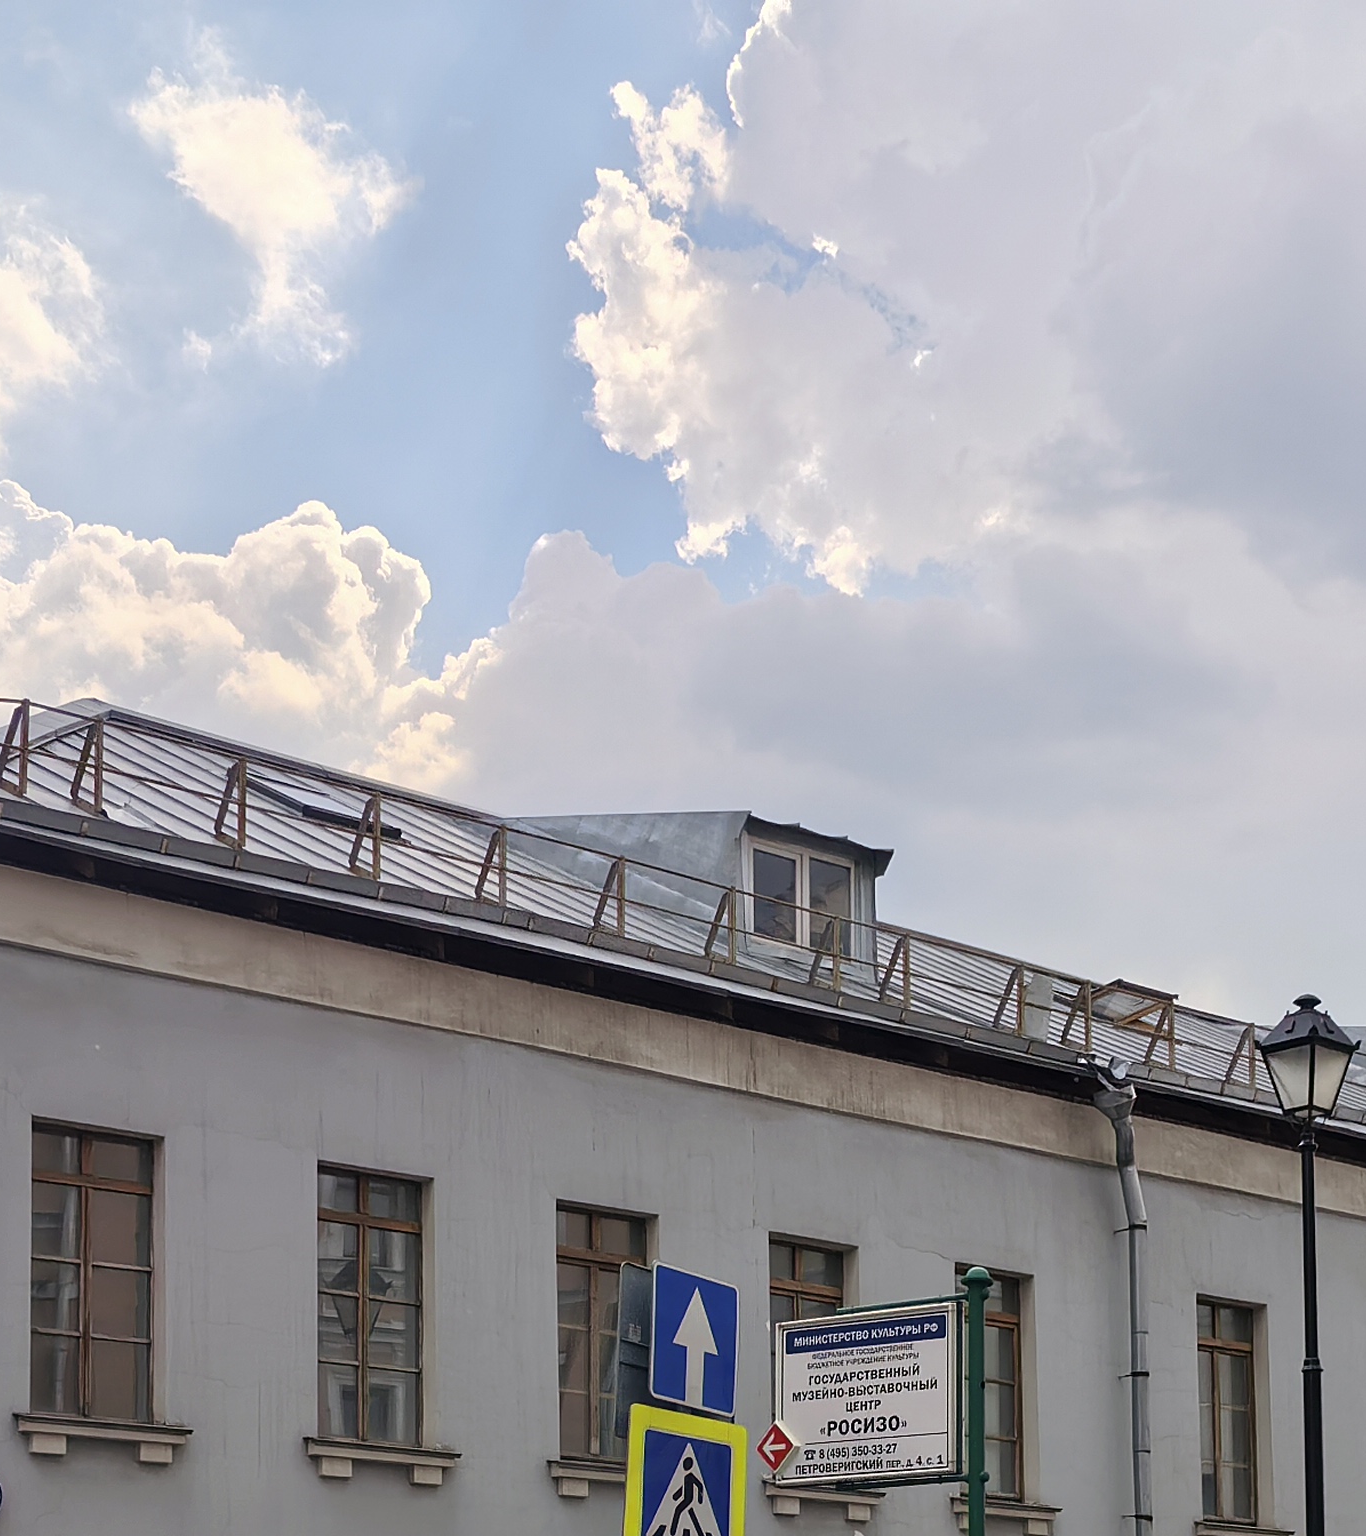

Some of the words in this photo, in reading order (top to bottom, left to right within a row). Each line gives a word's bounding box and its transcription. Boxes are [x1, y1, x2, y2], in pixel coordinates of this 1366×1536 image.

[793, 1329, 869, 1347] МИНИСТЕРСТВО
[871, 1324, 922, 1339] КУЛЬТУРЫ
[923, 1323, 939, 1334] РФ
[808, 1362, 921, 1386] ГОСУДАРСТВЕННЫЙ
[792, 1376, 939, 1402] МУЗЕЙНО-ВЫСТАВОЧНЫЙ
[845, 1399, 882, 1413] ЦЕНТР
[819, 1415, 908, 1437] «РОСИЗО»
[818, 1448, 825, 1460] 8
[826, 1446, 850, 1460] (495)
[851, 1443, 898, 1457] 350-33-27
[795, 1456, 883, 1476] ПЕТРОВЕРИГСКИЙ
[936, 1454, 944, 1465] 1
